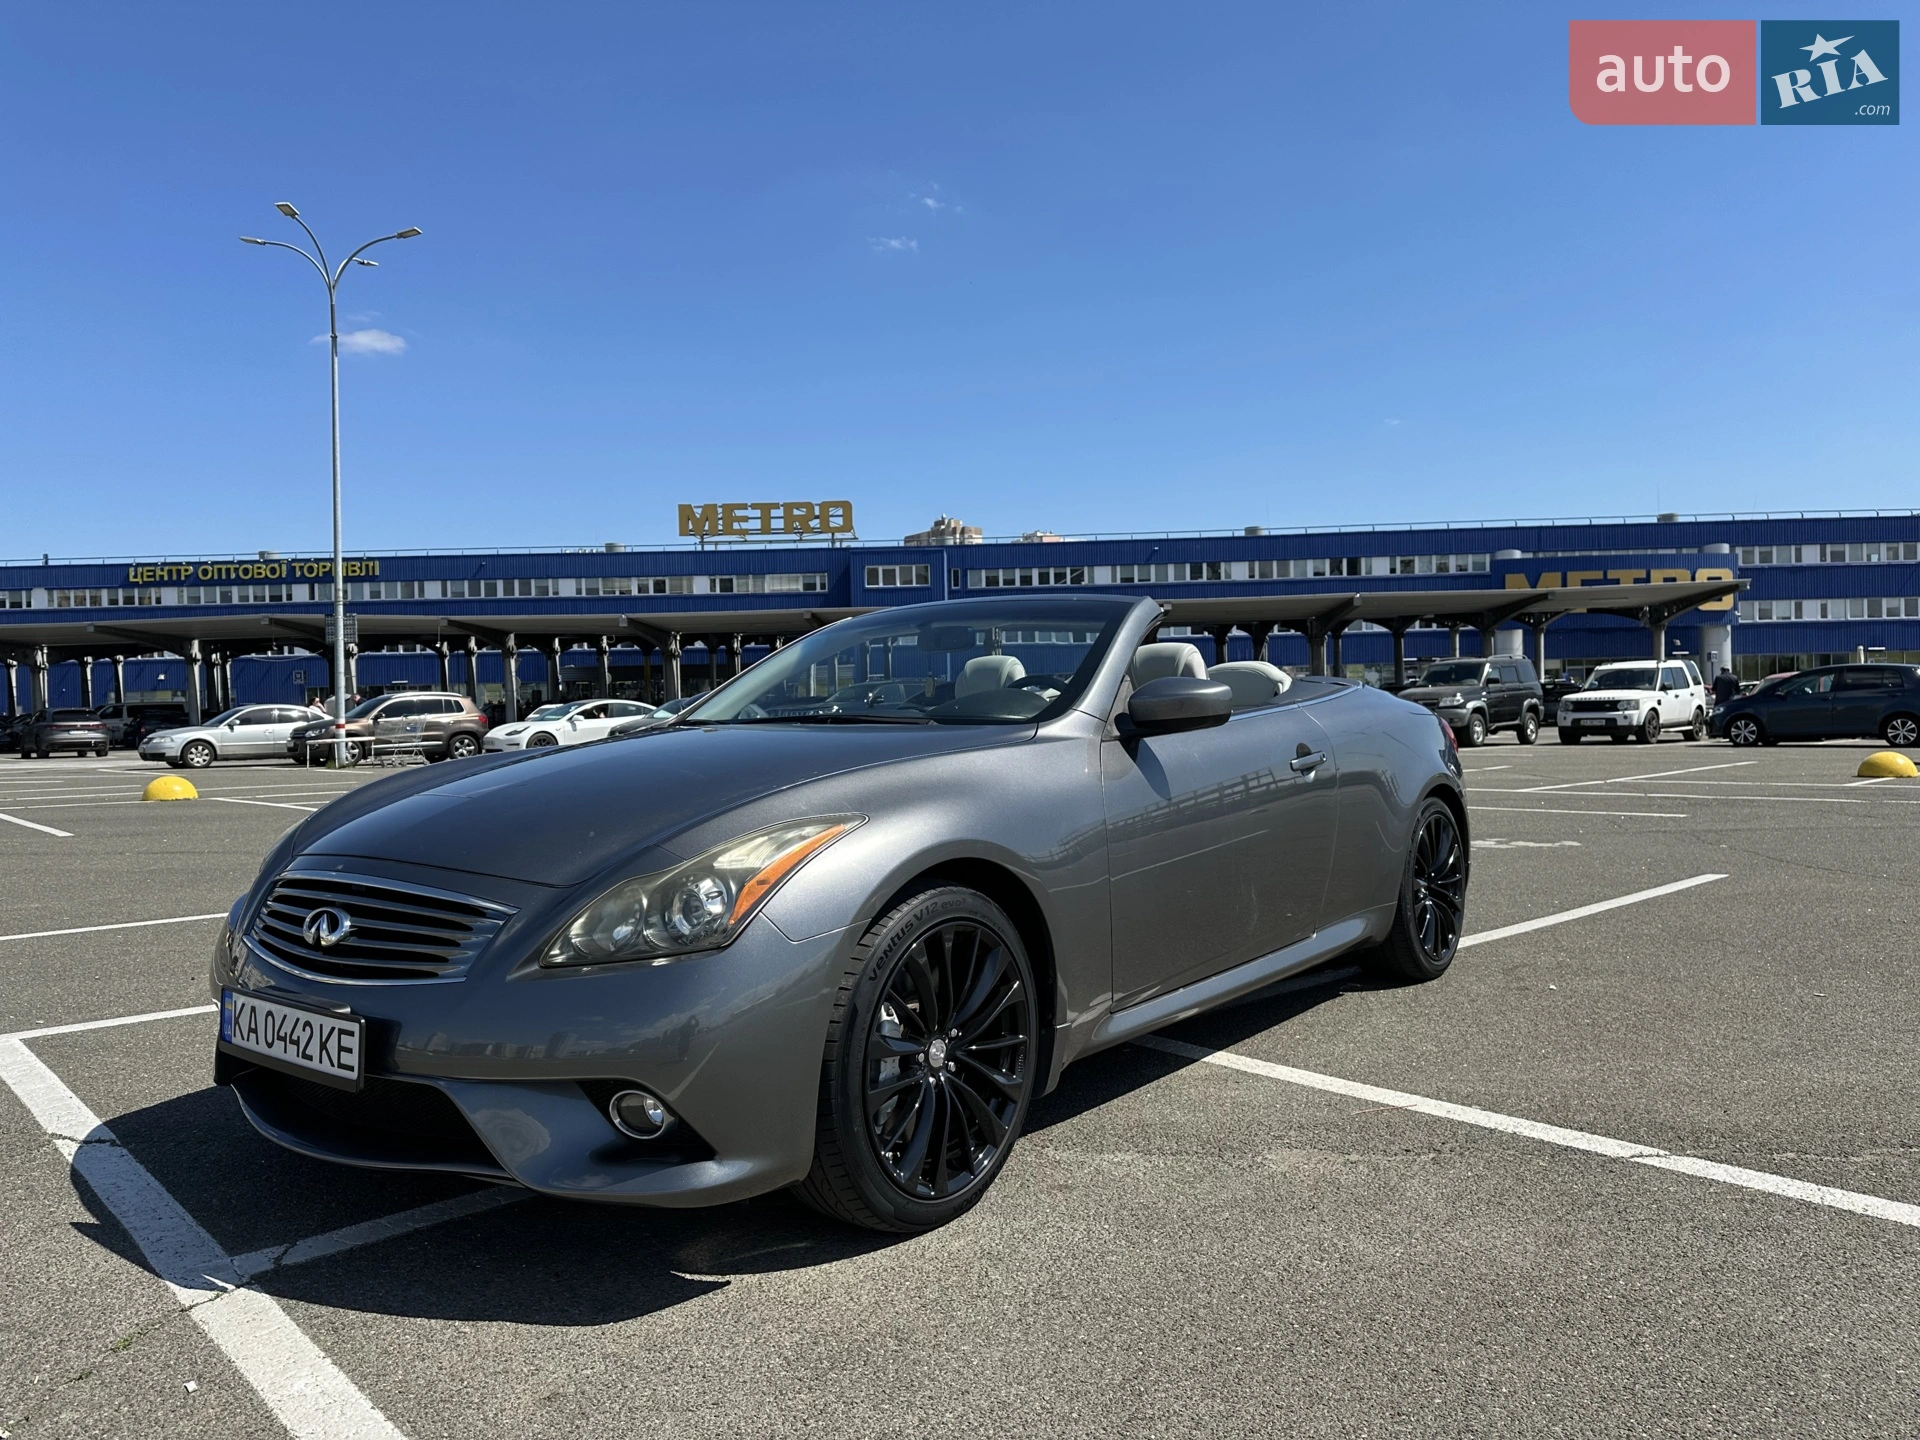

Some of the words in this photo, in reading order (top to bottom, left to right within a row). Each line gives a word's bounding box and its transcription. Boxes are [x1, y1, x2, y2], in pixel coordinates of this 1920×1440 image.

[678, 500, 853, 536] METRO
[128, 565, 193, 584] ЦЕНТР
[198, 560, 287, 580] ОПТОВОЇ
